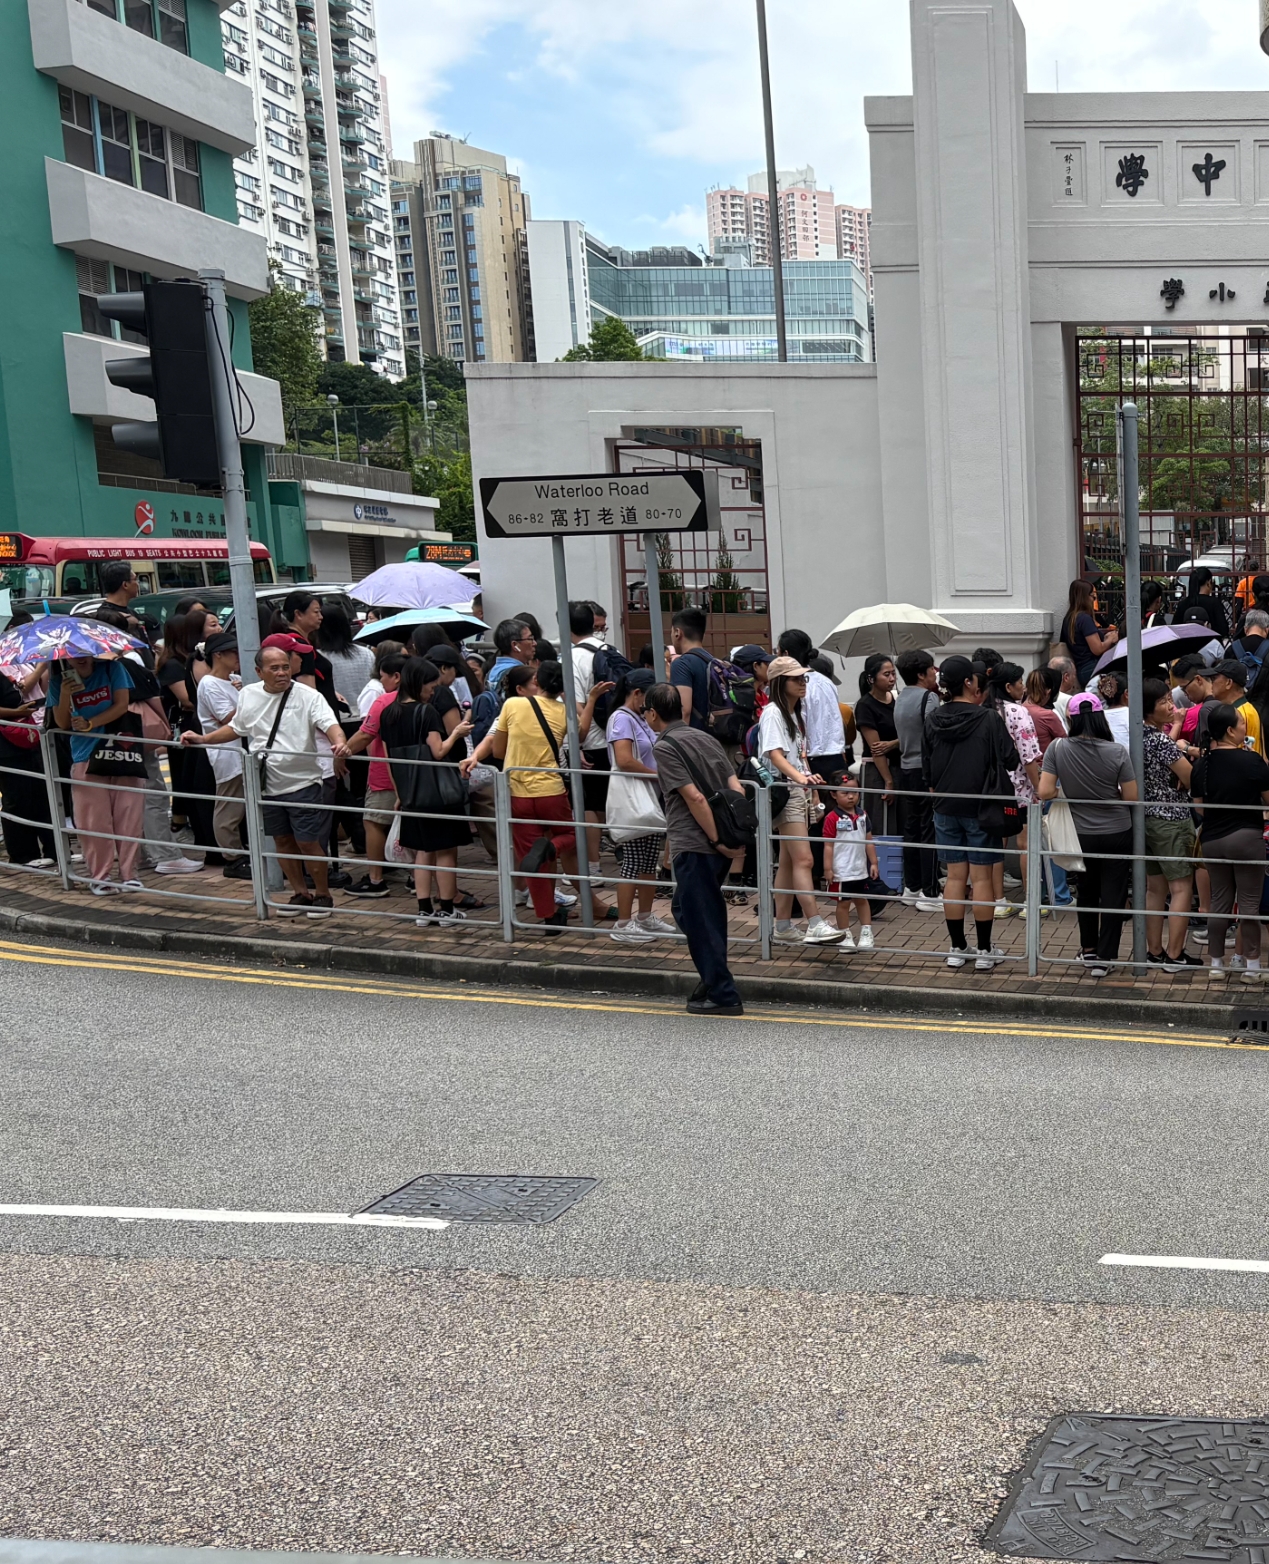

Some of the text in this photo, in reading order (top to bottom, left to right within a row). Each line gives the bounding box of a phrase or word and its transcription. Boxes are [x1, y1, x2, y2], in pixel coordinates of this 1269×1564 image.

[534, 482, 649, 499] Waterloo Road
[508, 506, 682, 527] 86-82 窩打老道 80-70
[87, 549, 105, 557] PUBLIC
[108, 549, 122, 557] LIGHT
[125, 549, 135, 557] BUS
[146, 549, 161, 557] SEATS
[95, 749, 143, 763] JESUS
